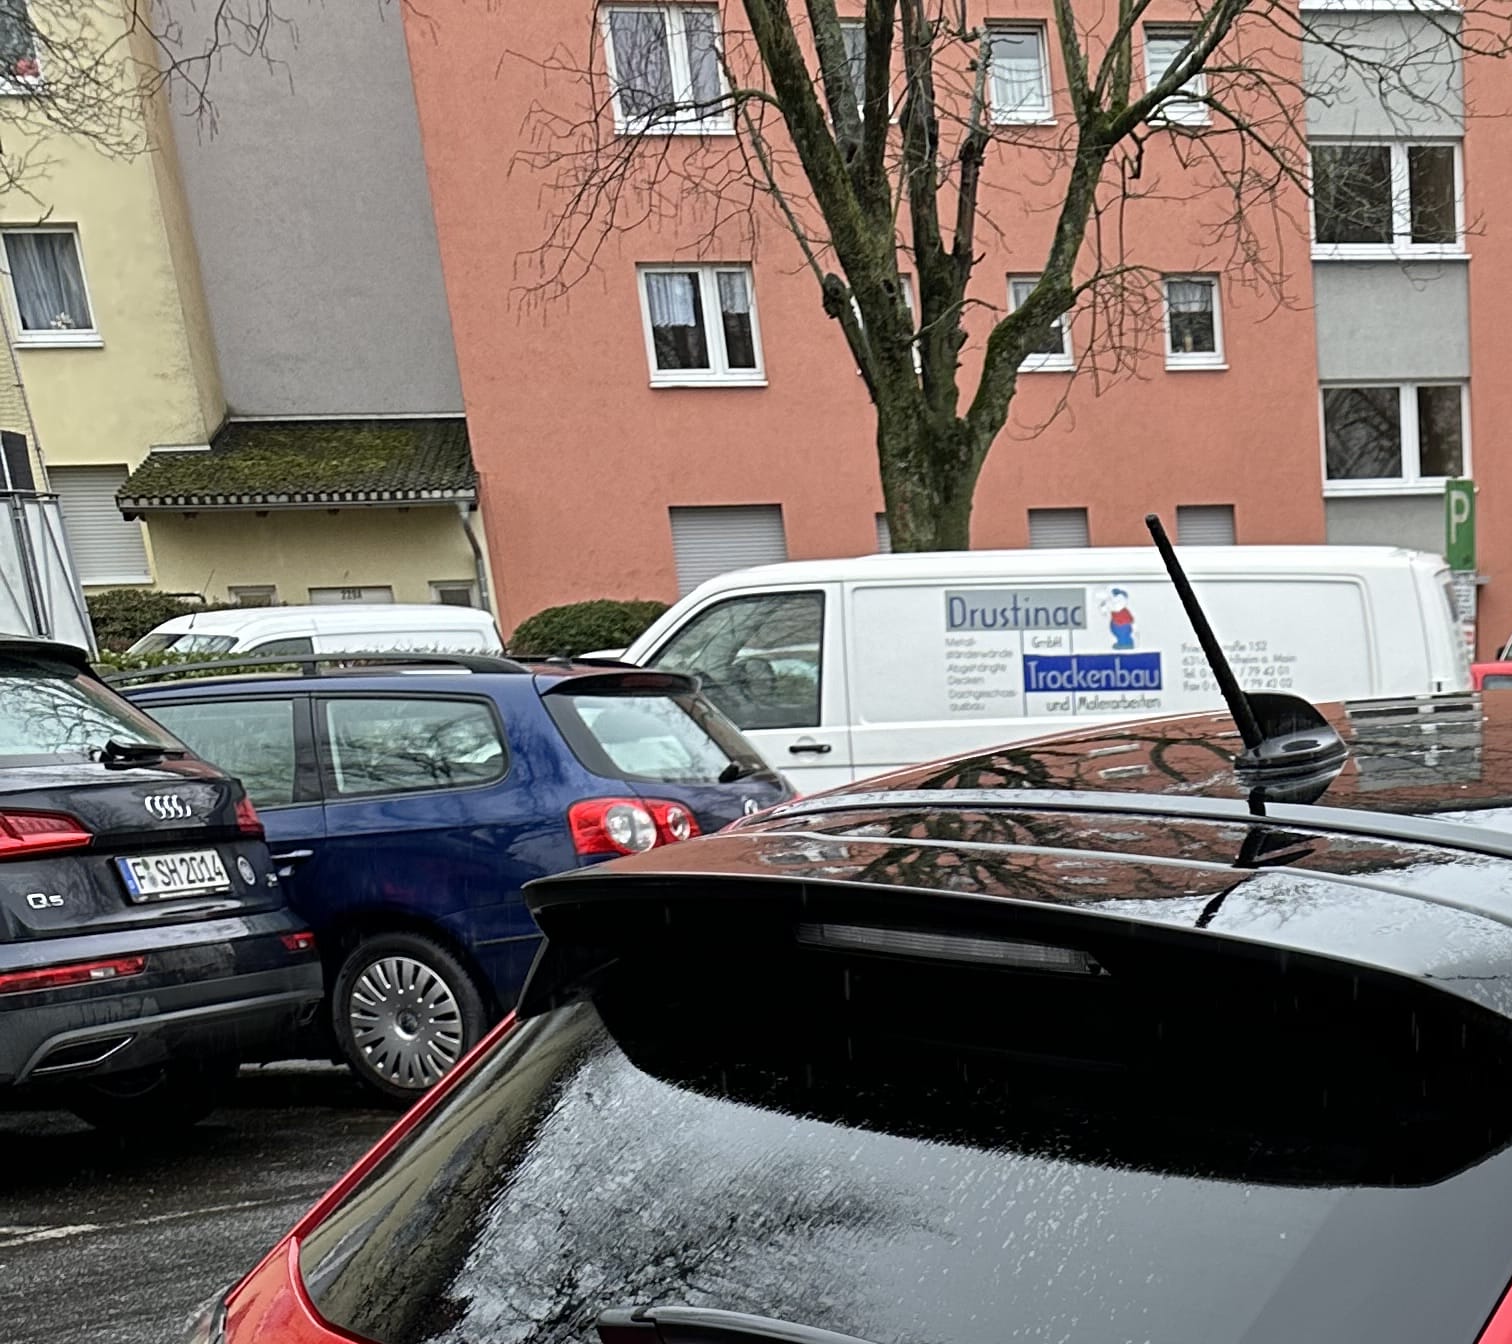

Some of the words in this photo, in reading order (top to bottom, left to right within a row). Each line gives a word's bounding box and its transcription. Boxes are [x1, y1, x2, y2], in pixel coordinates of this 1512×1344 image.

[1450, 490, 1470, 545] P
[949, 594, 1082, 628] Drustinac
[1027, 657, 1160, 689] Trockenbau
[1046, 696, 1071, 711] und
[131, 861, 147, 890] F
[155, 858, 184, 887] SH
[180, 854, 225, 885] 2014
[26, 892, 64, 909] Q5
